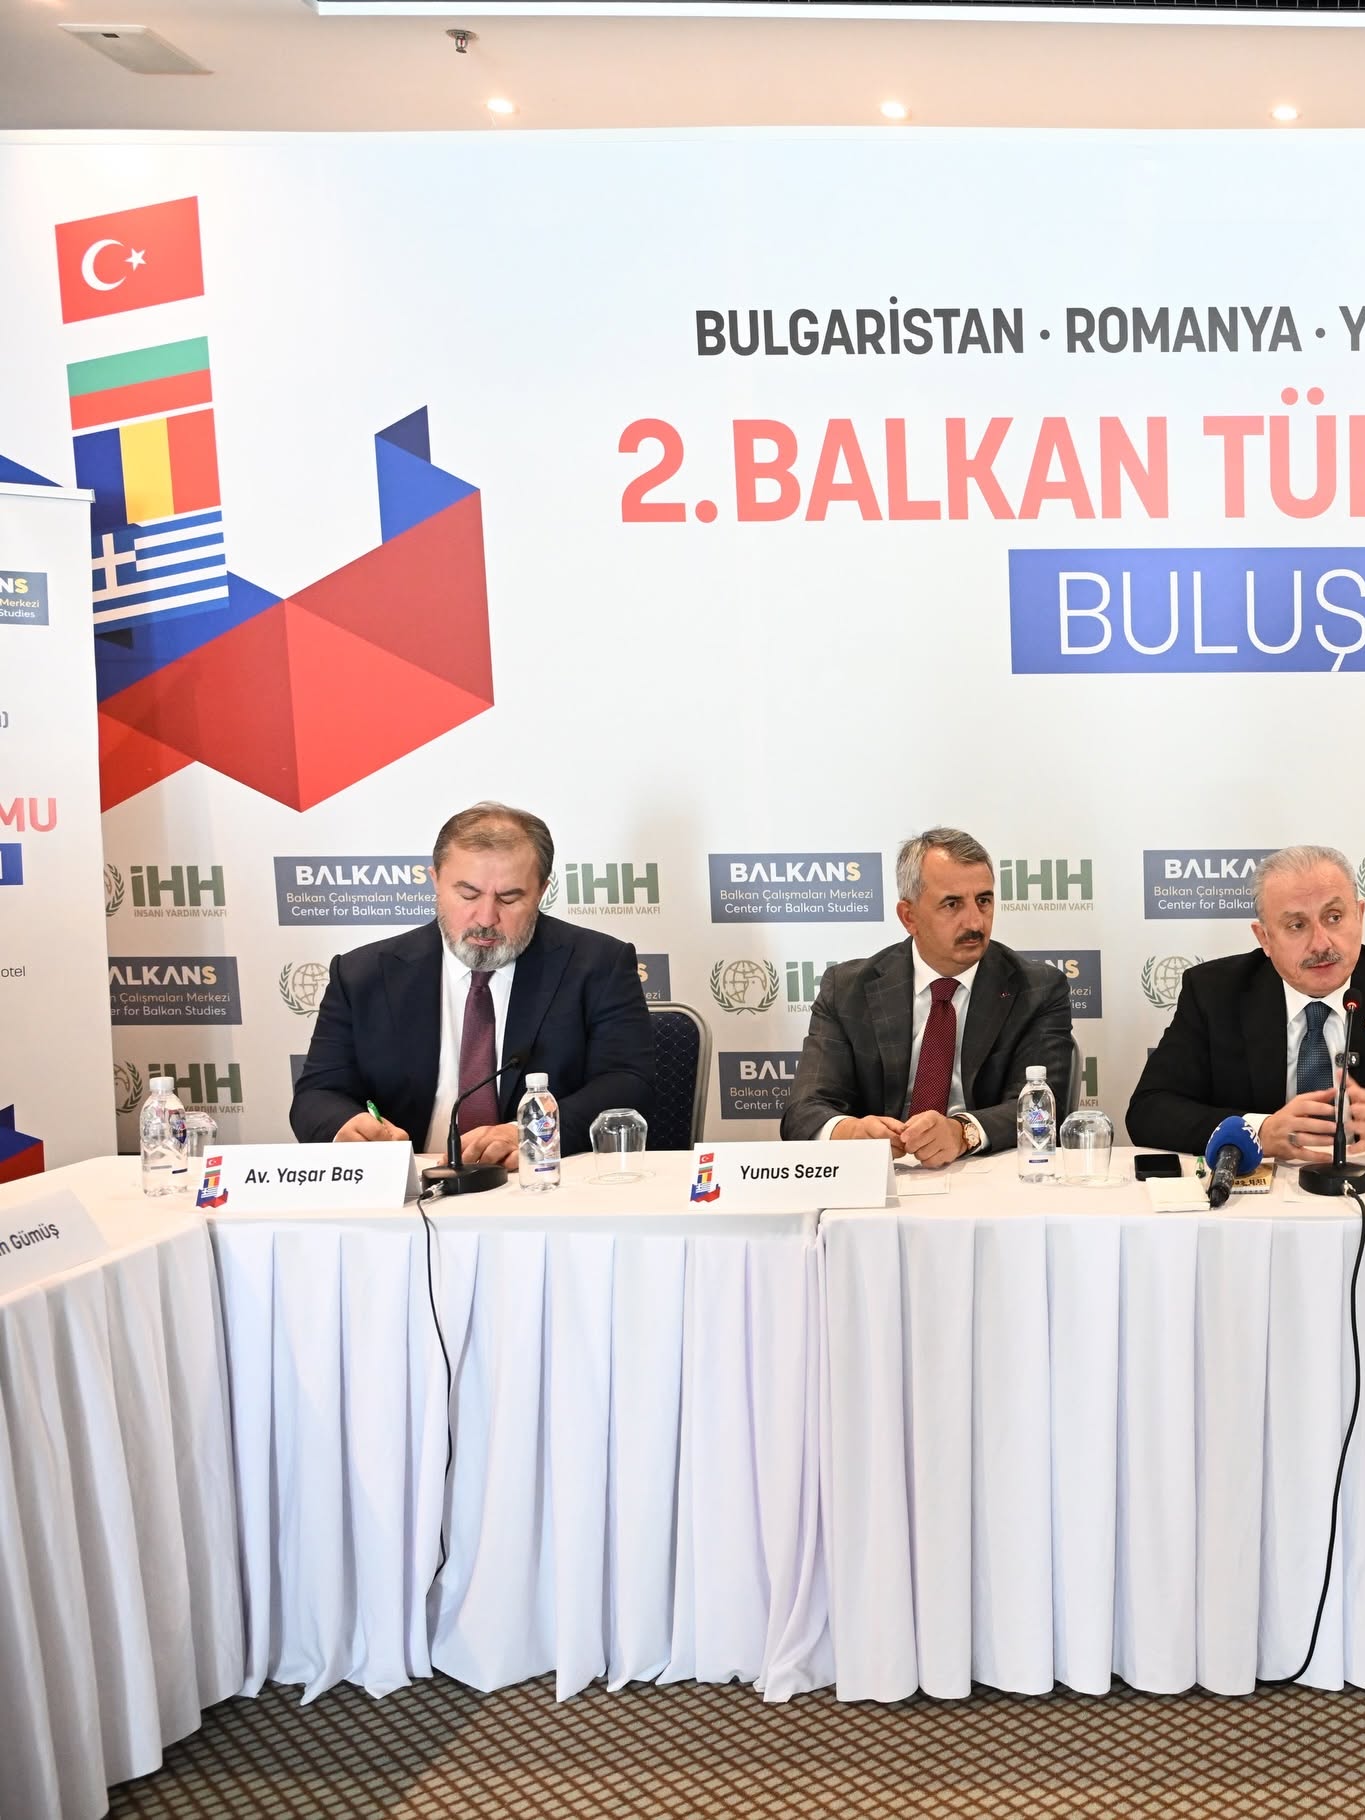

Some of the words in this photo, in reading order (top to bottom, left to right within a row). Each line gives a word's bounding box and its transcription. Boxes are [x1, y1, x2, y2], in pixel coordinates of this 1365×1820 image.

[696, 295, 1024, 356] BULGARİSTAN
[1066, 306, 1302, 353] ROMANYA
[730, 862, 861, 883] BALKANS
[1165, 858, 1259, 879] BALKA
[295, 865, 426, 886] BALKANS
[720, 890, 759, 900] Balkan
[830, 889, 873, 899] Merkezi
[1154, 886, 1193, 896] Balkan
[286, 892, 325, 903] Balkan
[396, 892, 437, 902] Merkez
[725, 903, 763, 914] Center
[766, 903, 782, 913] for
[785, 903, 824, 913] Balkan
[827, 902, 869, 913] Studies
[1158, 900, 1196, 910] Center
[1200, 899, 1216, 909] for
[291, 906, 329, 917] Center
[333, 905, 349, 916] for
[352, 905, 391, 916] Balkan
[395, 905, 436, 916] Studies
[0, 966, 26, 978] otel
[109, 966, 217, 986] ALKANS
[186, 992, 230, 1003] Merkezi
[124, 1006, 140, 1016] for
[143, 1006, 182, 1016] Balkan
[185, 1005, 227, 1016] Studies
[730, 1087, 769, 1097] Balkan
[734, 1100, 772, 1110] Center
[245, 1169, 270, 1184] Av.
[277, 1168, 326, 1186] Yaşar
[331, 1166, 364, 1185] Baş
[740, 1165, 790, 1180] Yunus
[794, 1164, 840, 1179] Sezer
[9, 1223, 60, 1249] Gümüş
